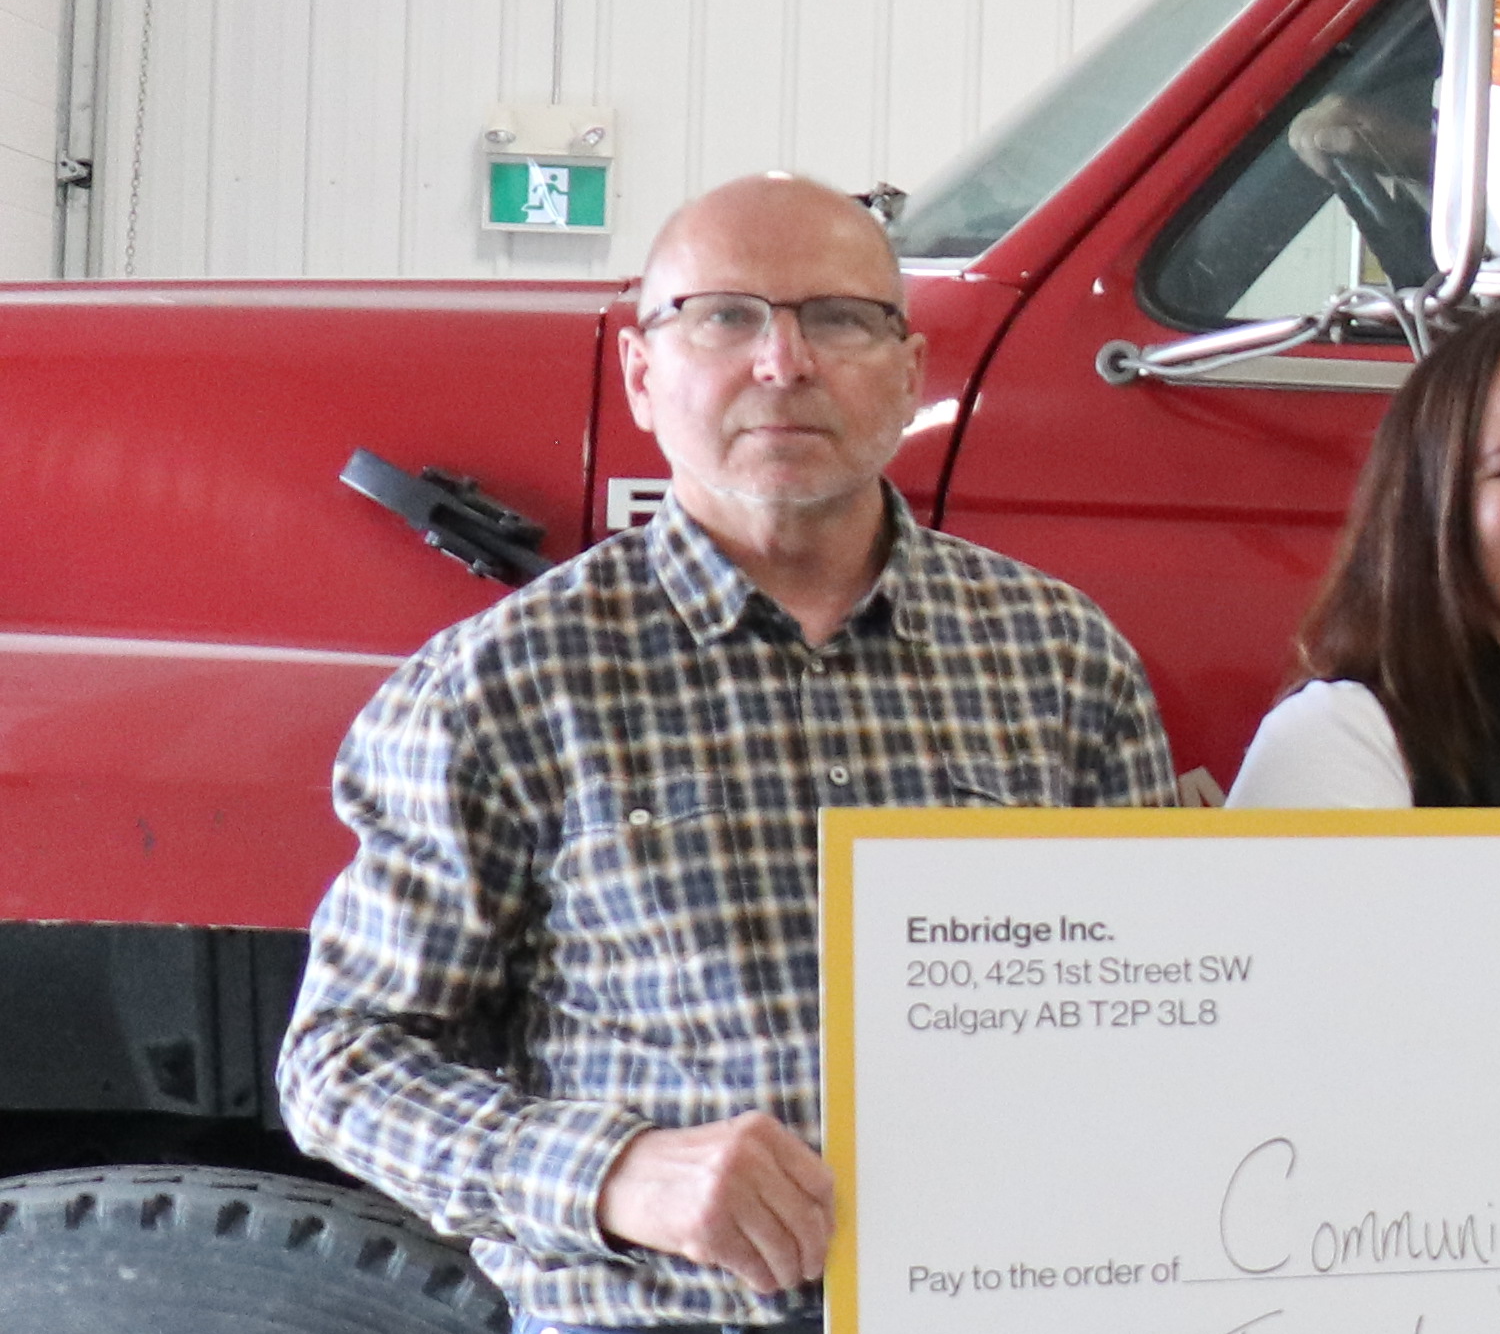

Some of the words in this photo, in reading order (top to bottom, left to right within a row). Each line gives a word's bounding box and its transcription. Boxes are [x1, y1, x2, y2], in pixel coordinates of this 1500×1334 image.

[907, 916, 1052, 948] Enbridge
[1060, 916, 1115, 943] Inc.
[906, 959, 979, 989] 200,
[985, 958, 1046, 985] 425
[1055, 957, 1092, 984] 1st
[1099, 955, 1192, 984] Street
[1199, 955, 1252, 983] SW
[907, 1002, 1028, 1034] Calgary
[1035, 1001, 1081, 1028] AB
[1088, 1000, 1151, 1027] T2P
[1157, 999, 1218, 1026] 3L8
[909, 1264, 965, 1297] Pay
[973, 1267, 1001, 1291] to
[1008, 1262, 1057, 1288] the
[1063, 1259, 1146, 1287] order
[1151, 1256, 1180, 1284] of
